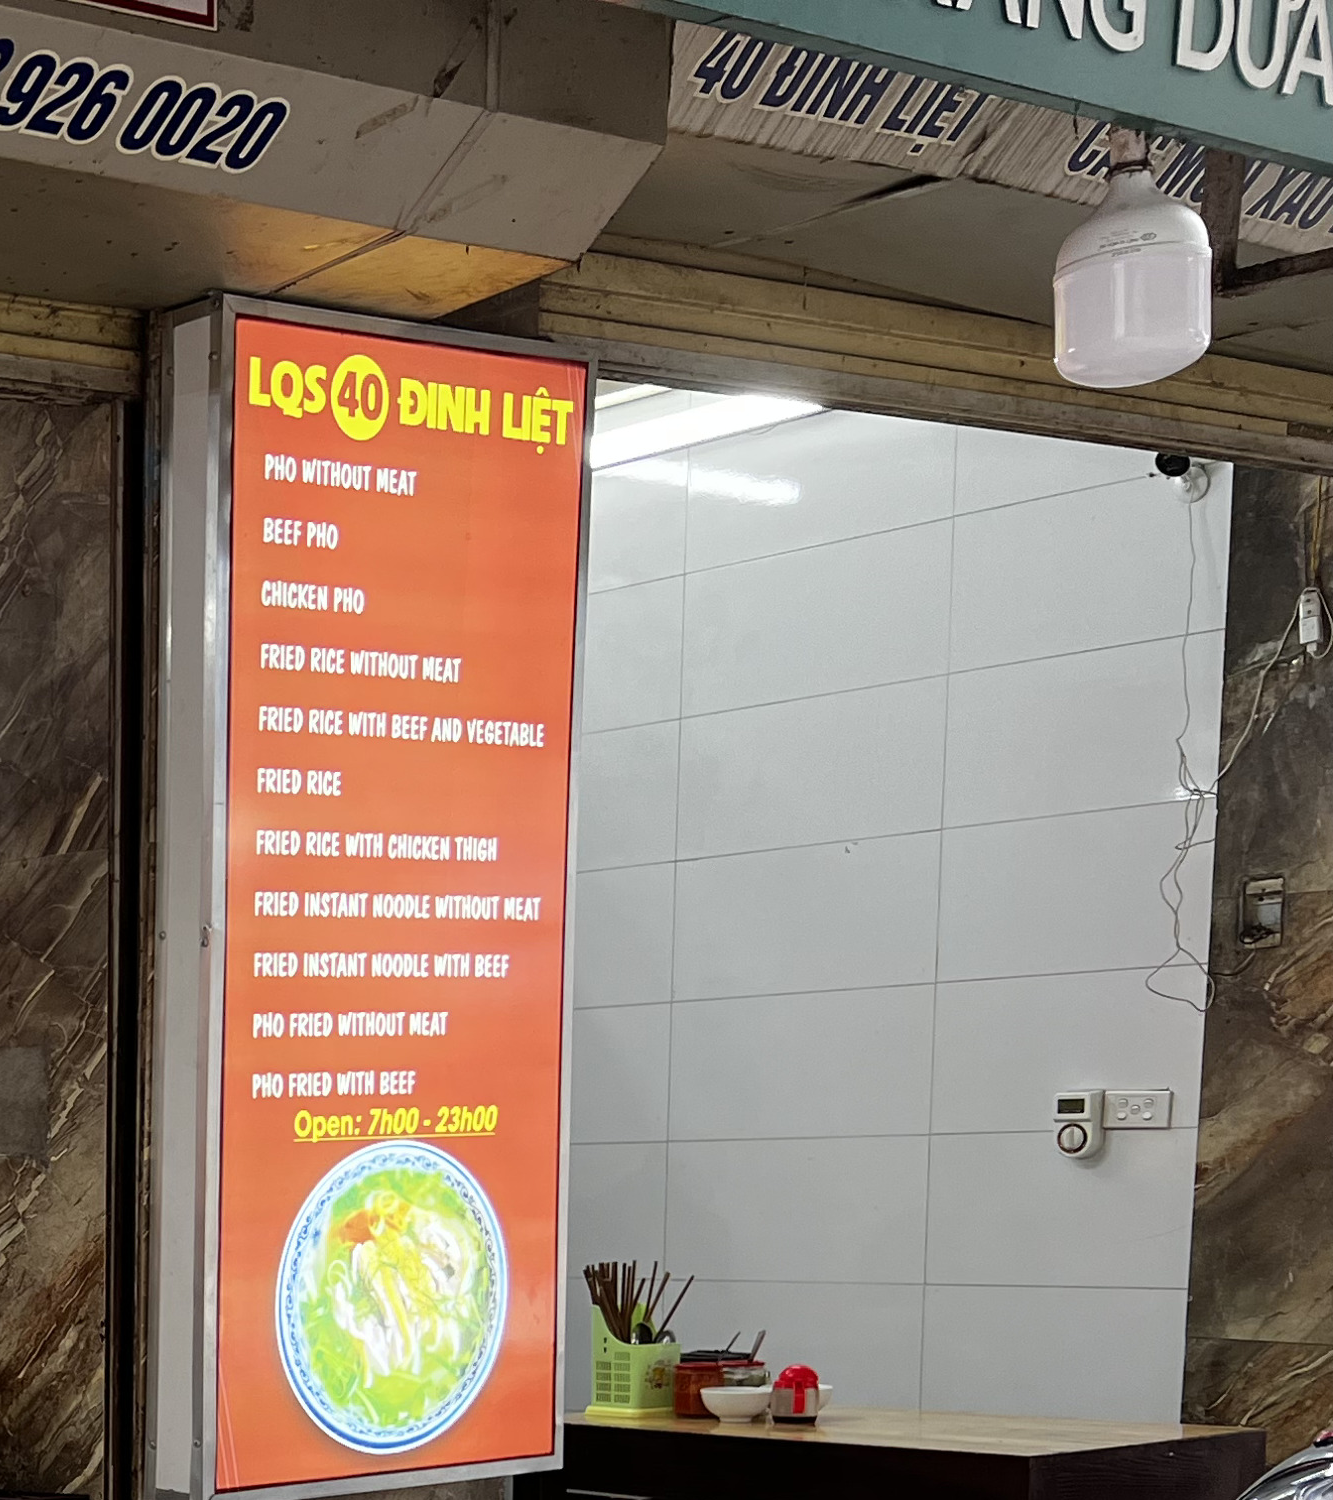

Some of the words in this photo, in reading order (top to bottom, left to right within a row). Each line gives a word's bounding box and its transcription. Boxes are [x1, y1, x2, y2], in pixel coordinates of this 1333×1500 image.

[248, 356, 328, 419] LQS
[337, 370, 383, 417] 40
[396, 377, 491, 436] ĐINH
[503, 386, 574, 455] LIỆT
[264, 453, 298, 483] PHO
[301, 458, 373, 492] WITHOUT
[376, 467, 418, 497] MEAT
[262, 517, 303, 547] BEEF
[306, 521, 340, 550] PHO
[261, 579, 330, 611] CHICKEN
[333, 586, 366, 615] PHO
[260, 643, 306, 672] FRIED
[310, 647, 346, 675] RICE
[350, 649, 420, 680] WITHOUT
[421, 655, 462, 684] MEAT
[258, 705, 304, 734] FRIED
[308, 708, 344, 736] RICE
[348, 711, 388, 738] WITH
[390, 713, 429, 741] BEEF
[430, 716, 464, 743] AND
[466, 718, 545, 748] VEGETABLE
[256, 767, 303, 795] FRIED
[306, 769, 342, 797] RICE
[255, 829, 302, 856] FRIED
[305, 830, 341, 857] RICE
[344, 831, 384, 858] WITH
[387, 833, 452, 862] CHICKEN
[453, 835, 499, 862] THIGH
[254, 890, 300, 918] FRIED
[303, 891, 370, 919] INSTANT
[372, 893, 432, 920] NOODLE
[434, 893, 502, 921] WITHOUT
[503, 896, 542, 922] MEAT
[253, 951, 299, 978] FRIED
[303, 951, 368, 979] INSTANT
[370, 952, 430, 979] NOODLE
[433, 951, 472, 978] WITH
[474, 953, 511, 979] BEEF
[252, 1011, 286, 1039] PHO
[289, 1011, 334, 1038] FRIED
[337, 1011, 407, 1037] WITHOUT
[408, 1011, 449, 1037] MEAT
[252, 1071, 285, 1099] PHO
[288, 1071, 334, 1098] FRIED
[336, 1069, 376, 1096] WITH
[379, 1070, 417, 1096] BEEF
[294, 1108, 362, 1143] Open:
[367, 1106, 420, 1135] 7h00
[435, 1105, 499, 1135] 23h00
